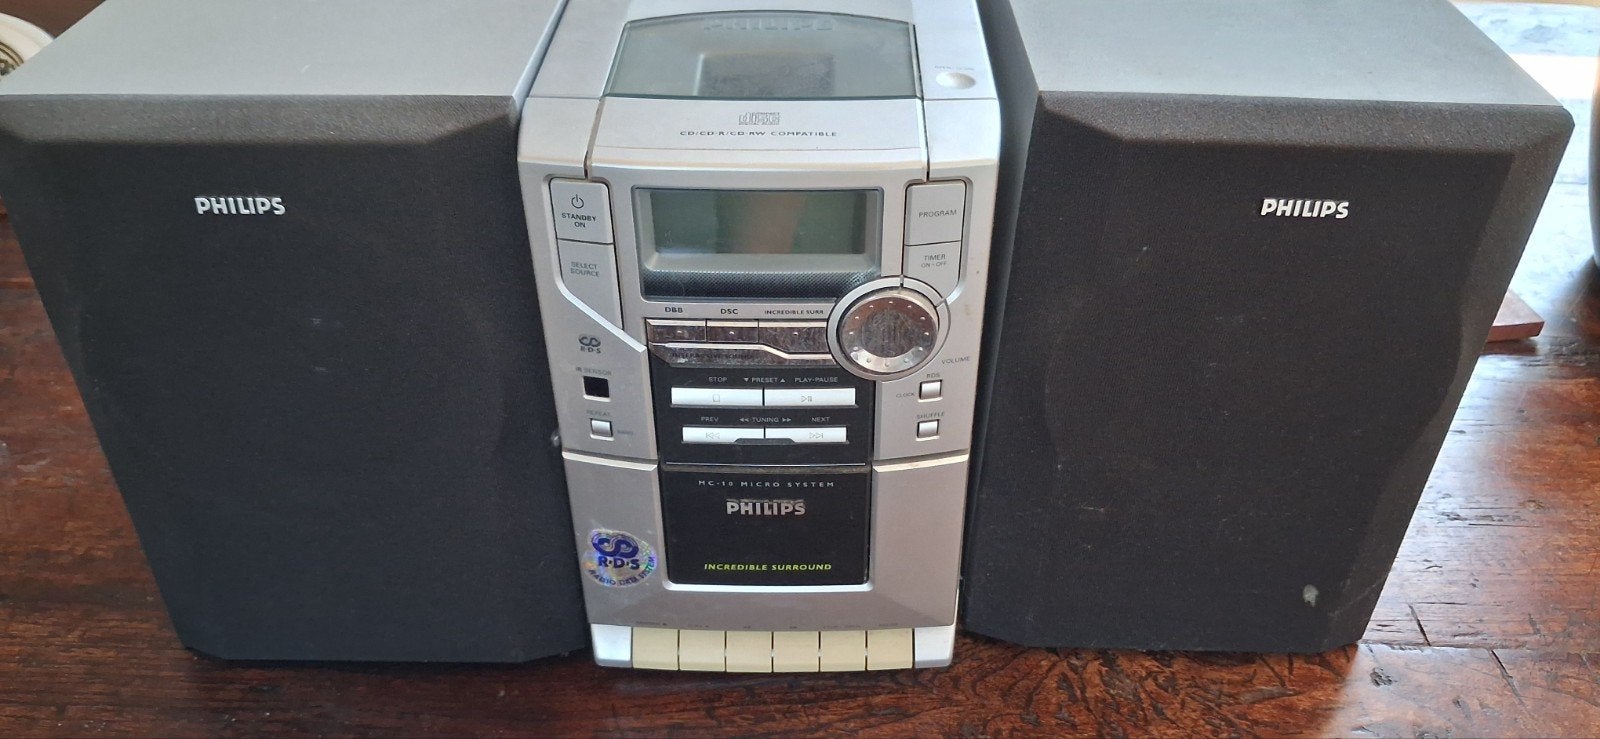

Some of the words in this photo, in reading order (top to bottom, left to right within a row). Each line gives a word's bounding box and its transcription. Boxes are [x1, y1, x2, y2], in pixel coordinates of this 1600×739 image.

[194, 196, 286, 215] PHILIPS
[1260, 198, 1350, 219] PHILIPS
[561, 212, 597, 222] STANDBY
[918, 209, 958, 219] PROGRAM
[574, 220, 587, 229] ON
[924, 253, 947, 261] TIMER
[571, 261, 598, 270] SELECT
[570, 268, 600, 278] SOURCE
[664, 306, 683, 314] DBB
[941, 355, 970, 365] VOLUME
[916, 411, 946, 420] SHUFFLE
[726, 500, 807, 517] PHILIPS
[704, 563, 768, 572] INCREDIBLE
[771, 563, 833, 572] SURROUND
[588, 569, 617, 586] RADIO
